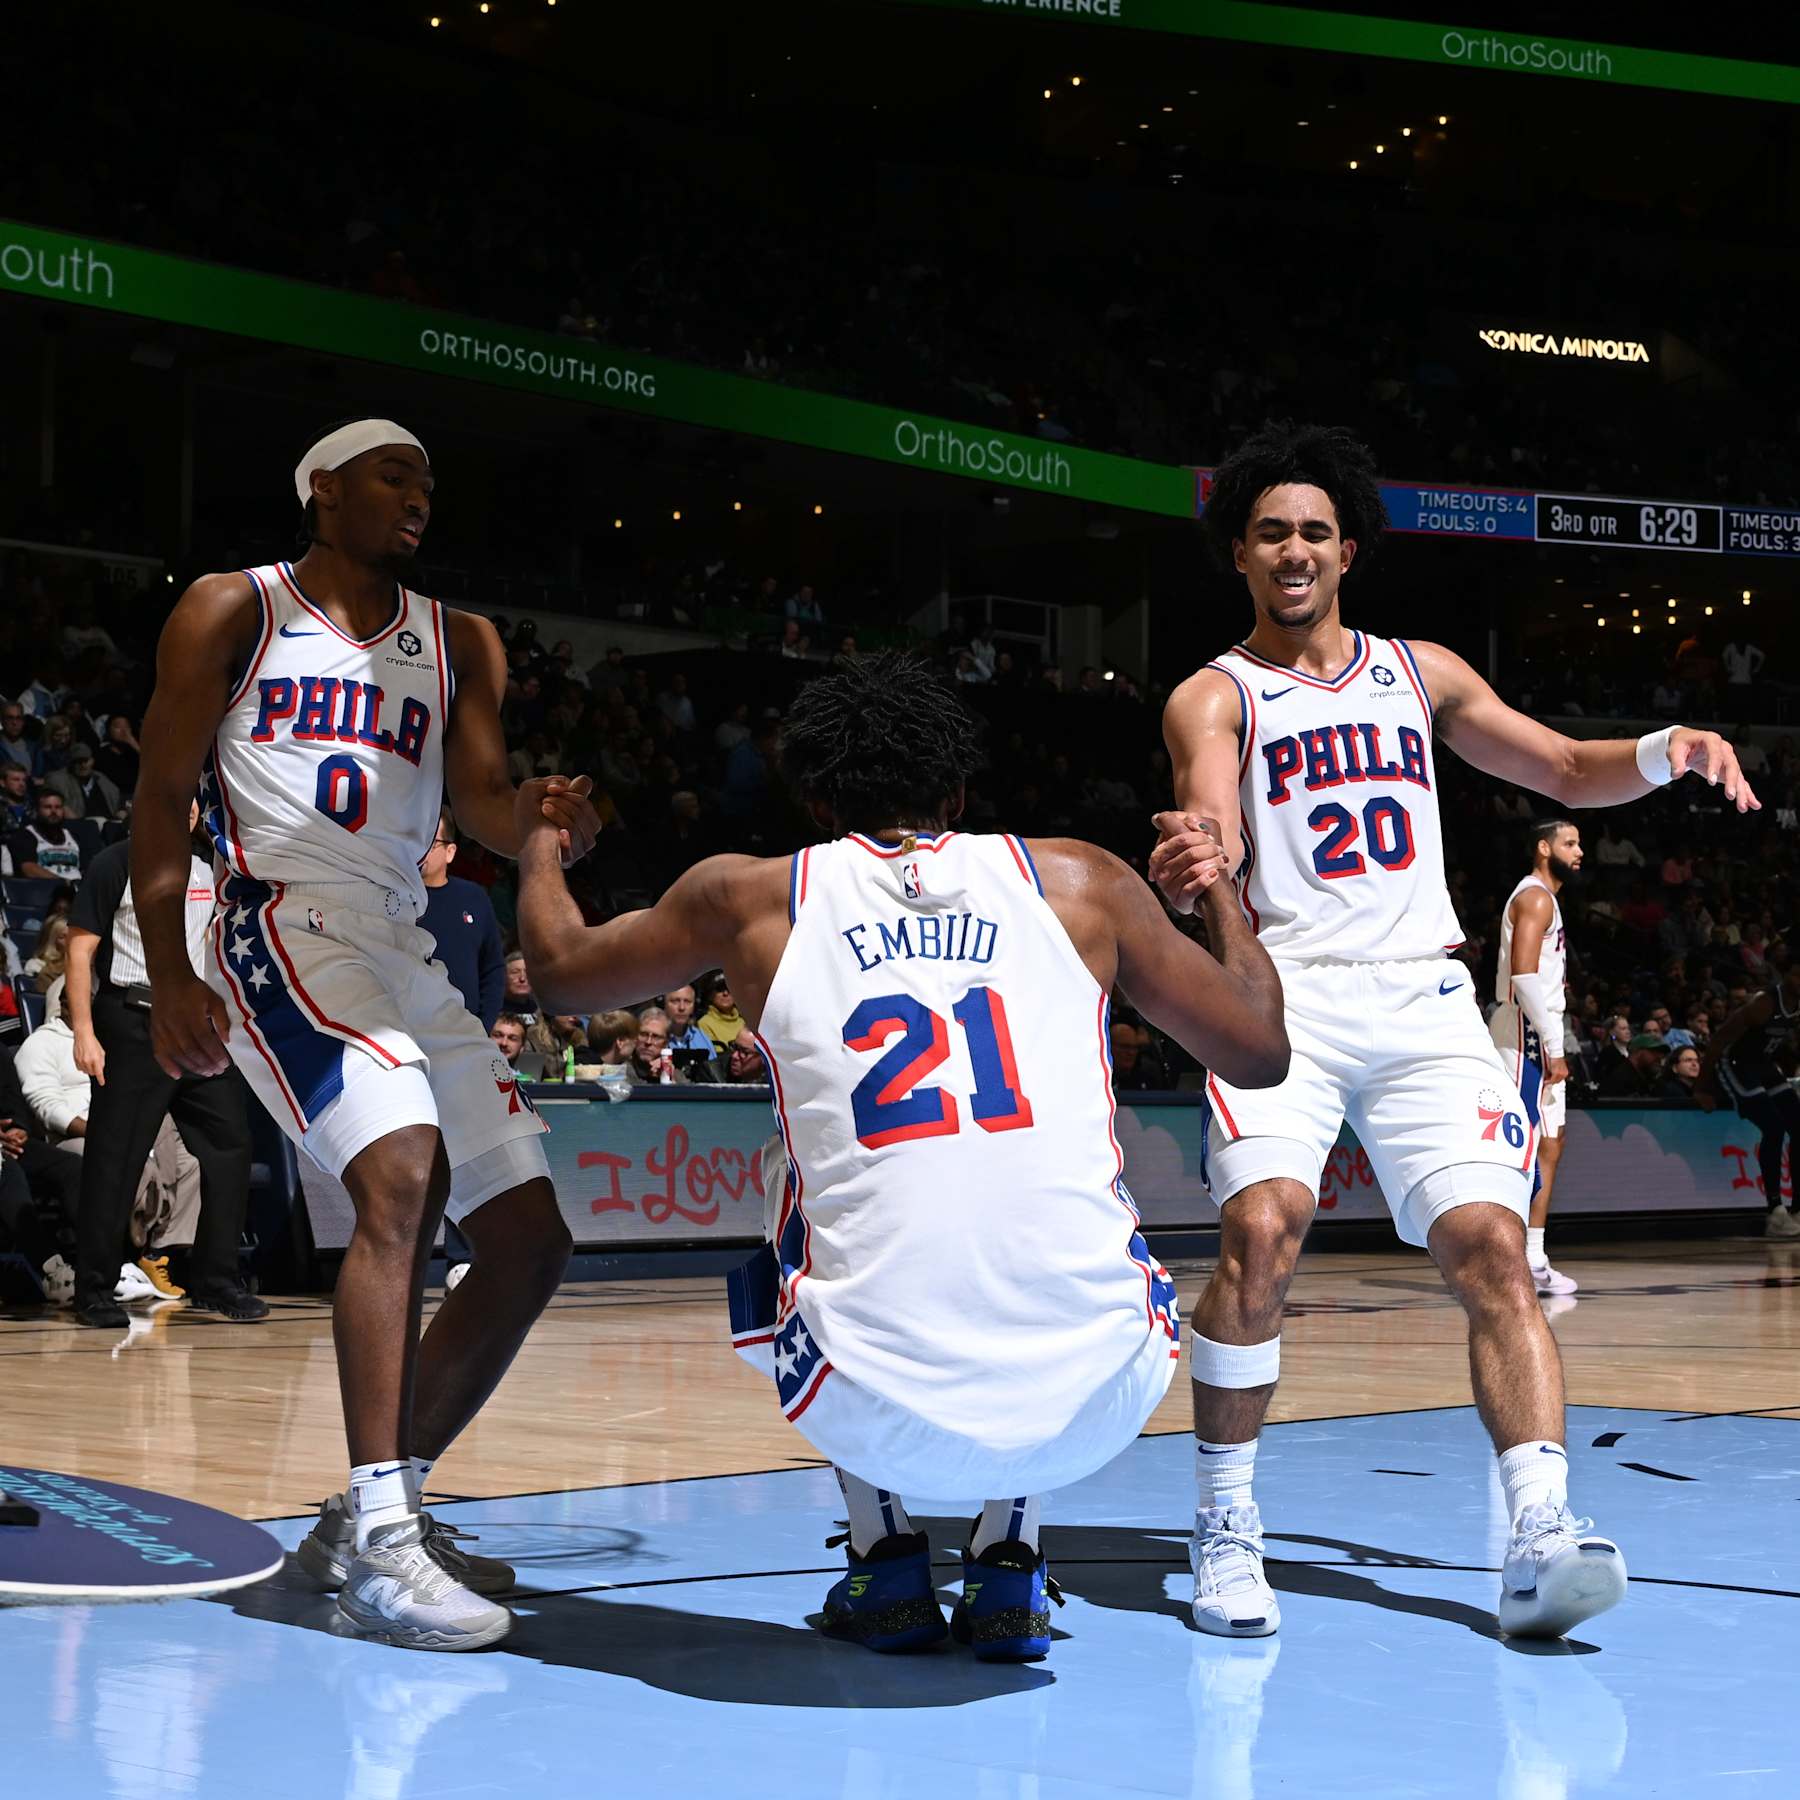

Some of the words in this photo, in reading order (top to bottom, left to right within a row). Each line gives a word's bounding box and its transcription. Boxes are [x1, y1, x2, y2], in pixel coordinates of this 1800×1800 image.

[981, 0, 1121, 17] RIENCE
[1441, 31, 1612, 76] OrthoSouth
[420, 329, 656, 397] ORTHOSOUTH.ORG
[1479, 330, 1560, 355] KONICA
[1561, 336, 1650, 363] MINOLTA
[895, 420, 1071, 488] OrthoSouth
[1417, 491, 1513, 513] TIMEOUTS:
[1516, 499, 1528, 514] 4
[1417, 512, 1480, 532] FOULS:
[1484, 517, 1497, 533] 0
[1551, 505, 1583, 533] 3RD
[1590, 515, 1617, 537] QTR
[1640, 506, 1698, 545] 6:29
[1730, 532, 1789, 551] FOULS:
[1792, 536, 1800, 551] 3
[385, 655, 436, 672] crypto.com
[1369, 689, 1413, 700] crypto.com
[250, 676, 432, 768] PHILA
[1261, 723, 1431, 806] PHILA
[315, 754, 369, 834] 0
[1307, 796, 1416, 880] 20
[842, 912, 998, 972] EMBIID
[842, 986, 1034, 1151] 21
[1478, 1105, 1525, 1149] 76
[577, 1151, 636, 1216] I
